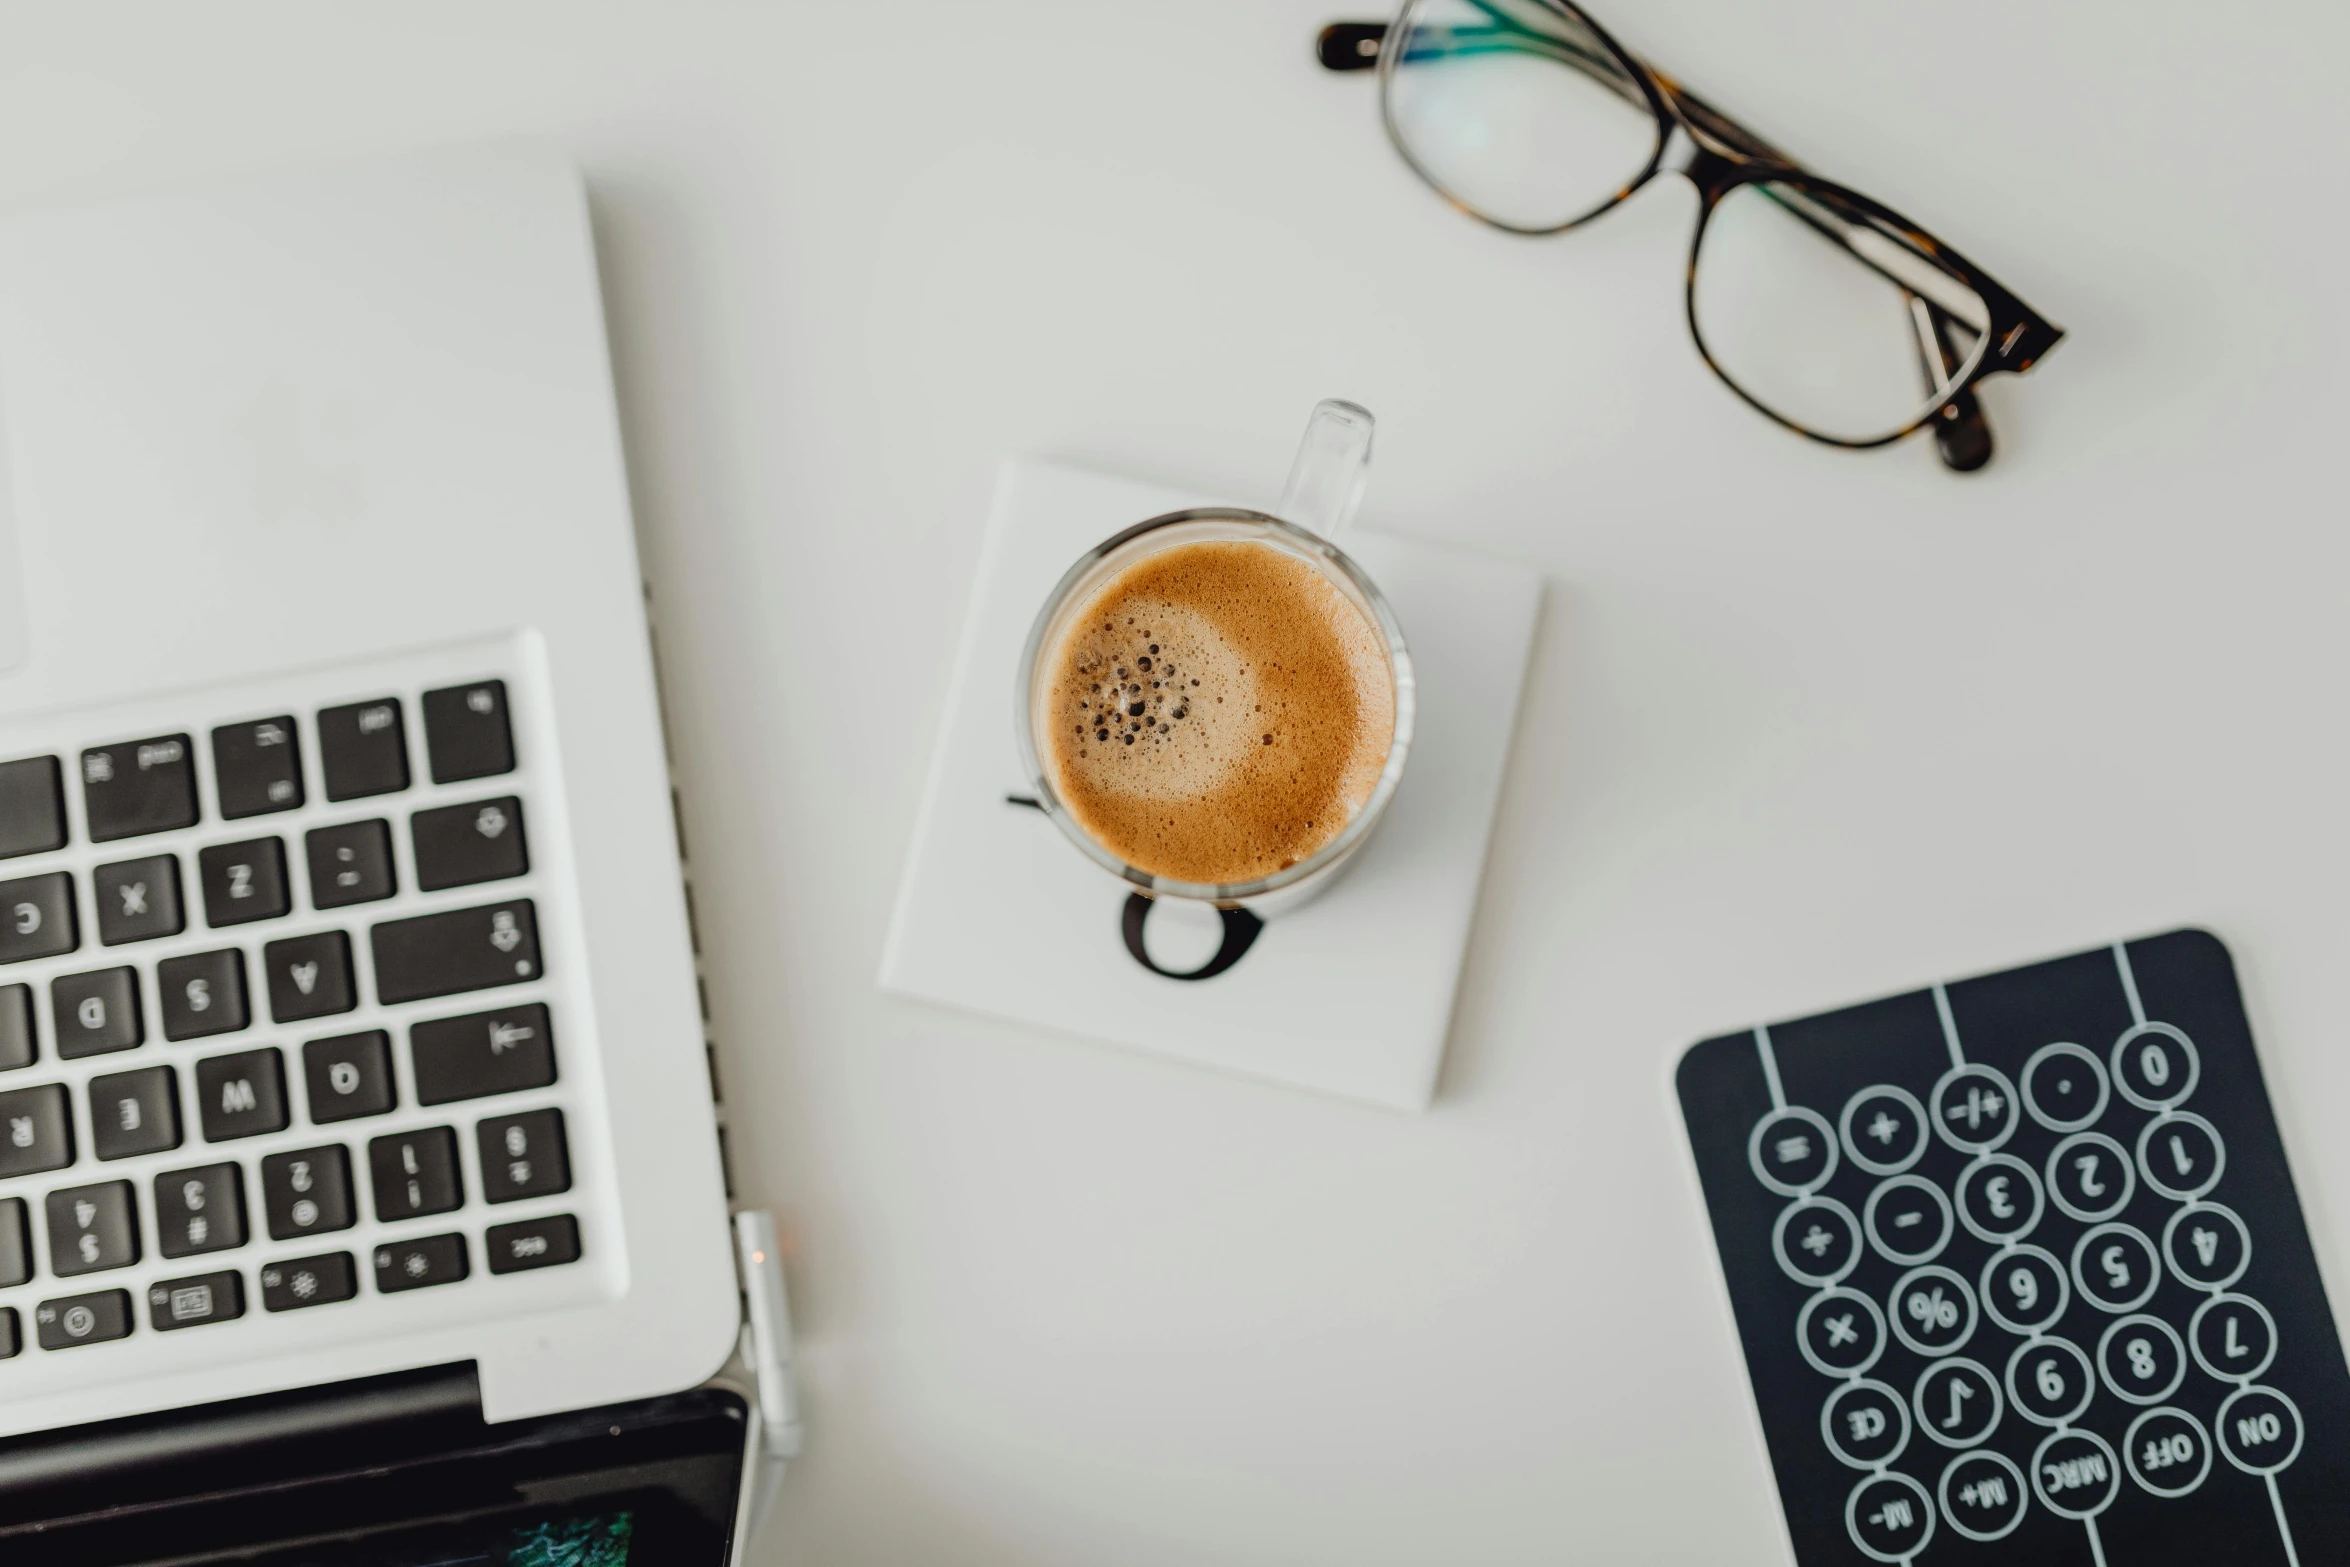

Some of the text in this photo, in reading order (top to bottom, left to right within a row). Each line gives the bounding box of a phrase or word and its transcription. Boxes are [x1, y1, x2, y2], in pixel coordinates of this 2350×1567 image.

[227, 863, 254, 899] Z
[119, 882, 147, 916] X
[14, 902, 41, 934] C
[290, 961, 318, 995] A
[186, 979, 211, 1012] S
[78, 997, 106, 1029] D
[328, 1061, 360, 1095] Q
[2140, 1044, 2169, 1086] 0
[222, 1079, 256, 1114] W
[10, 1115, 35, 1147] R
[119, 1098, 141, 1131] E
[1868, 1112, 1899, 1144] +
[402, 1144, 419, 1174] 1
[2169, 1135, 2193, 1175] 1
[289, 1161, 313, 1192] 2
[2075, 1154, 2105, 1197] 2
[183, 1180, 206, 1211] 3
[1985, 1176, 2015, 1219] 3
[75, 1200, 97, 1229] 4
[188, 1216, 208, 1246] #
[2191, 1226, 2219, 1267] 4
[2101, 1245, 2130, 1289] 5
[2009, 1268, 2038, 1310] 6
[1907, 1287, 1959, 1333] %
[2225, 1316, 2249, 1358] 7
[2126, 1338, 2156, 1380] 8
[2036, 1359, 2065, 1401] 9
[1847, 1407, 1886, 1441] CE
[2236, 1412, 2281, 1447] ON
[2143, 1433, 2194, 1471] OFF
[2042, 1454, 2108, 1494] MRC
[1959, 1477, 2008, 1509] M+
